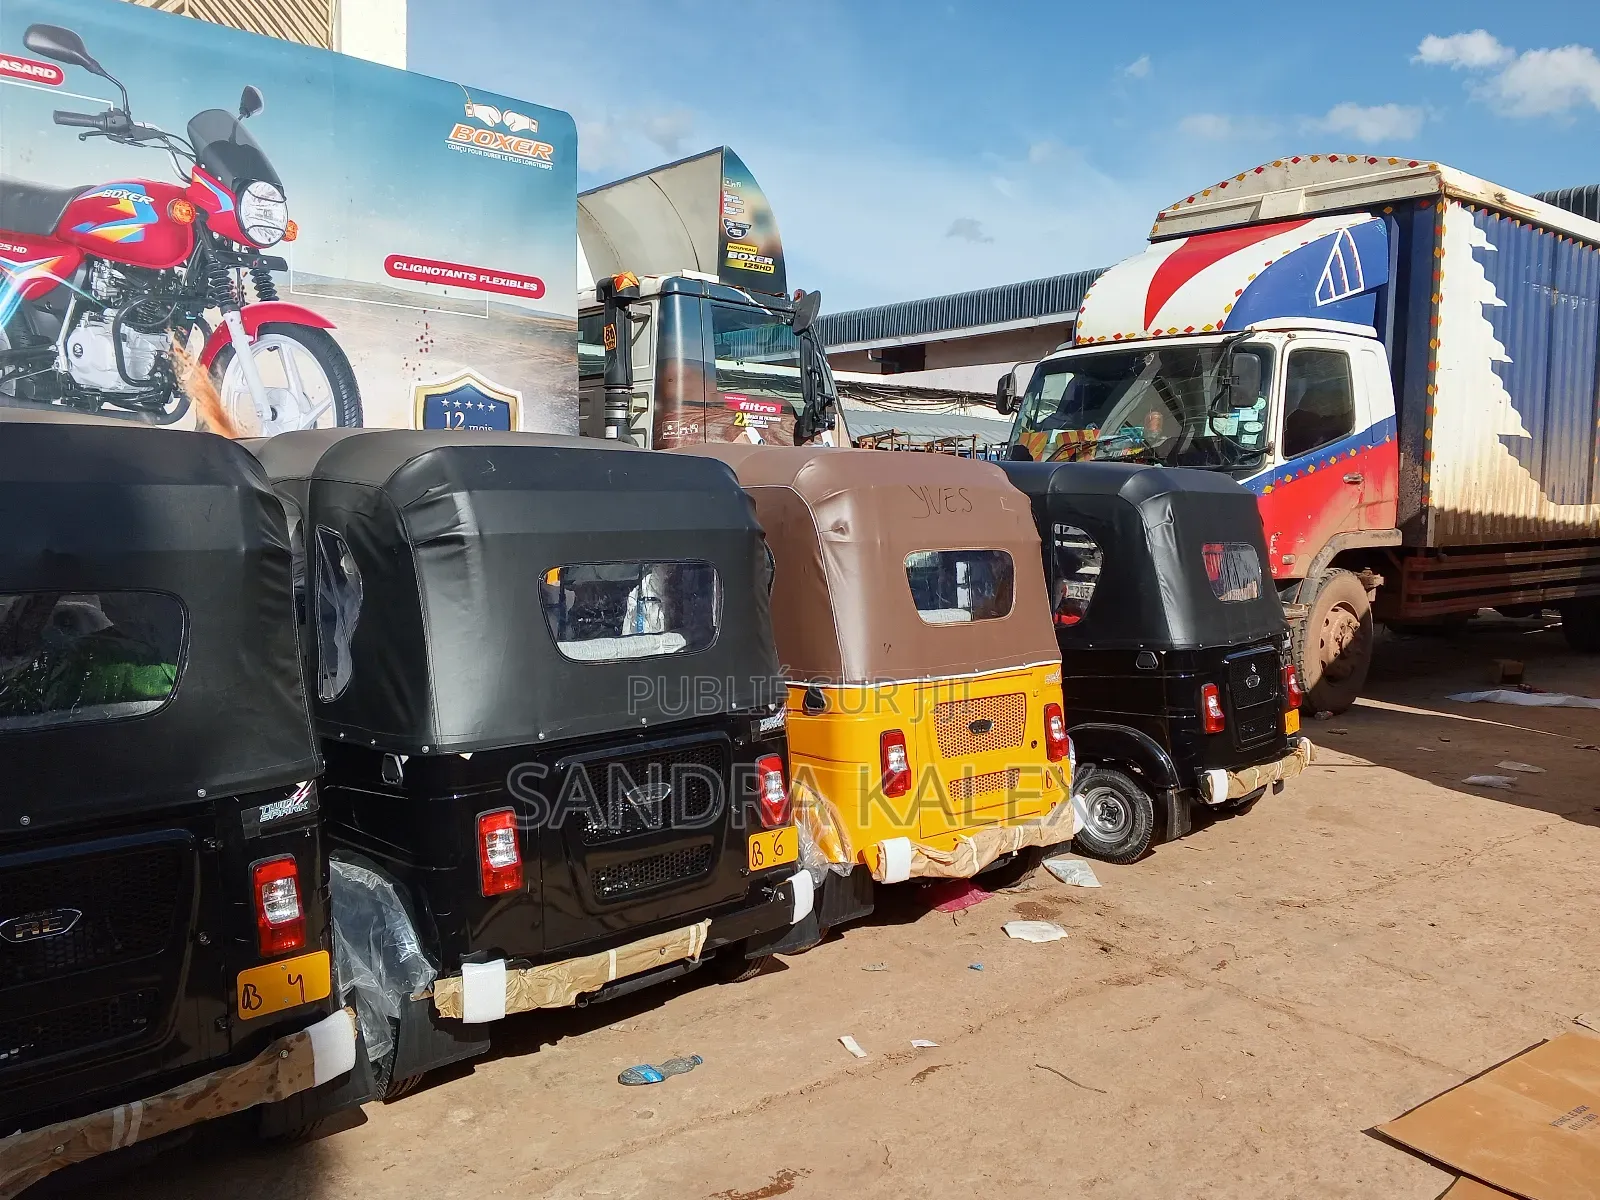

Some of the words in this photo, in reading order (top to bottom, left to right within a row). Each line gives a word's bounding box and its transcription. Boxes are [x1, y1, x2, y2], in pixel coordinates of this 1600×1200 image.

[448, 123, 554, 161] BOXER
[447, 143, 467, 154] CONÇU
[468, 147, 483, 157] POUR
[483, 151, 501, 160] DURER
[509, 156, 522, 165] PLUS
[522, 159, 553, 171] LONGTEMPS
[101, 189, 155, 205] BOXER
[12, 245, 28, 254] HD
[727, 250, 774, 265] BOXER
[393, 261, 477, 281] CLIGNOTANTS
[479, 274, 538, 292] FLEXIBLES
[739, 401, 777, 413] filtre
[443, 411, 466, 430] 12
[259, 800, 309, 823] SPARK
